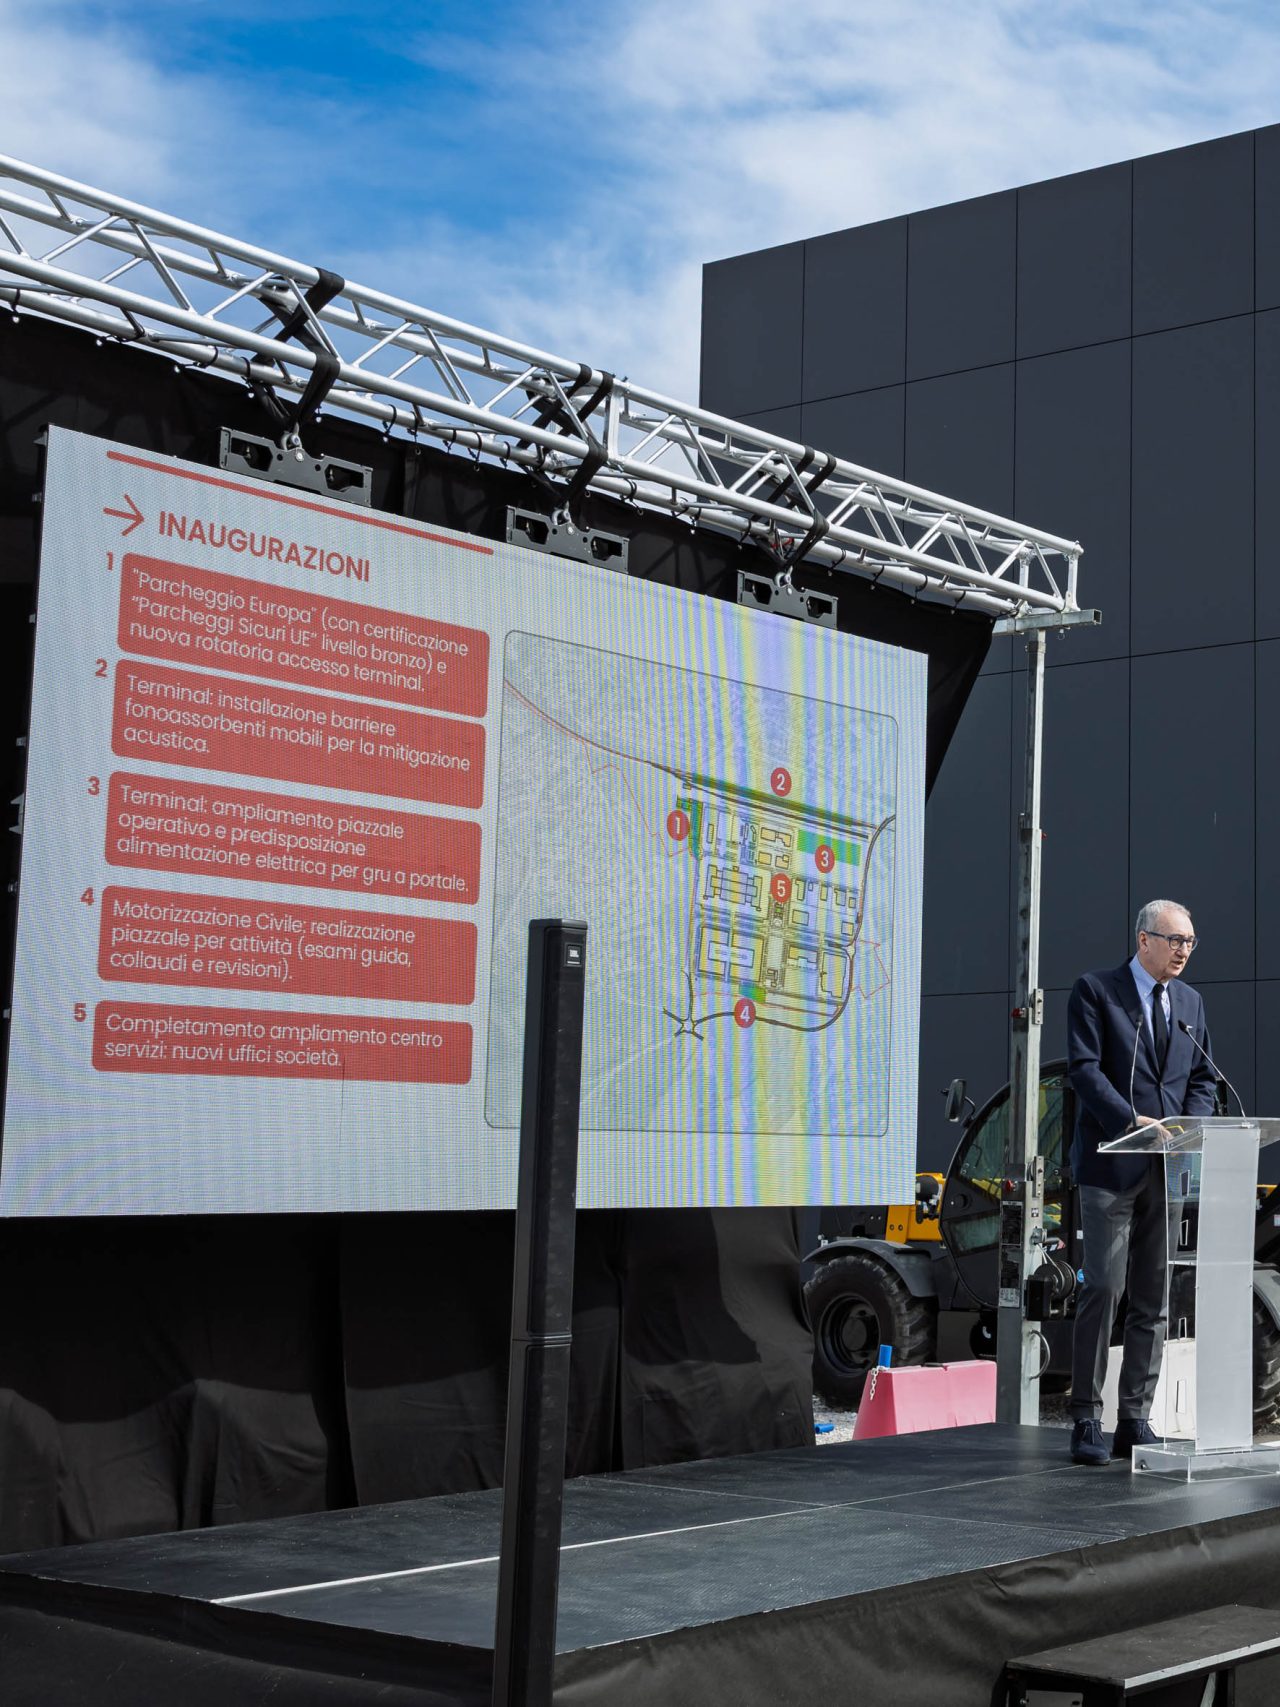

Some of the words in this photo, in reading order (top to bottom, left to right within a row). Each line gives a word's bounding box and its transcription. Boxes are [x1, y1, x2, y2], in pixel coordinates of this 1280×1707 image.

[106, 551, 114, 571] 1
[158, 510, 370, 583] INAUGURAZIONI
[238, 617, 287, 642] Sicuri
[322, 635, 368, 658] livello
[371, 643, 433, 675] bronzo)
[436, 661, 447, 674] e
[322, 606, 360, 634] (con
[363, 621, 469, 657] certificazione
[95, 658, 108, 678] 2
[129, 622, 190, 647] nuova
[194, 634, 273, 663] rotatoria
[277, 652, 350, 677] accesso
[353, 663, 425, 692] terminal.
[127, 674, 214, 705] Terminal:
[218, 689, 327, 725] installazione
[330, 709, 396, 737] barriere
[123, 726, 210, 753] acustica.
[125, 697, 266, 738] fonoassorbenti
[270, 725, 323, 747] mobili
[327, 735, 355, 754] per
[359, 737, 375, 756] la
[379, 743, 471, 771] mitigazione
[87, 776, 100, 796] 3
[776, 773, 785, 791] 2
[120, 784, 208, 813] Terminal:
[212, 801, 334, 830] ampliamento
[337, 815, 404, 840] piazzale
[674, 817, 681, 833] 1
[118, 812, 211, 838] operativo
[214, 825, 227, 840] e
[230, 827, 366, 857] predisposizione
[117, 835, 251, 867] alimentazione
[255, 851, 327, 875] elettrica
[331, 863, 359, 881] per
[362, 866, 391, 886] gru
[394, 870, 406, 885] a
[409, 872, 469, 892] portale.
[821, 851, 829, 867] 3
[80, 887, 95, 906] 4
[777, 880, 786, 897] 5
[113, 899, 252, 928] Motorizzazione
[256, 912, 307, 934] Civile:
[310, 919, 416, 944] realizzazione
[111, 924, 190, 948] piazzale
[193, 933, 226, 952] per
[229, 934, 292, 956] attività
[297, 935, 358, 960] (esami
[360, 945, 412, 968] guida,
[110, 950, 188, 973] collaudi
[191, 958, 204, 973] e
[207, 957, 293, 983] revisioni).
[73, 1003, 87, 1023] 5
[740, 1005, 751, 1022] 4
[106, 1012, 266, 1040] Completamento
[269, 1023, 387, 1046] ampliamento
[390, 1030, 443, 1048] centro
[104, 1040, 168, 1060] servizi:
[171, 1043, 223, 1061] nuovi
[228, 1043, 271, 1063] uffici
[275, 1047, 342, 1067] società.
